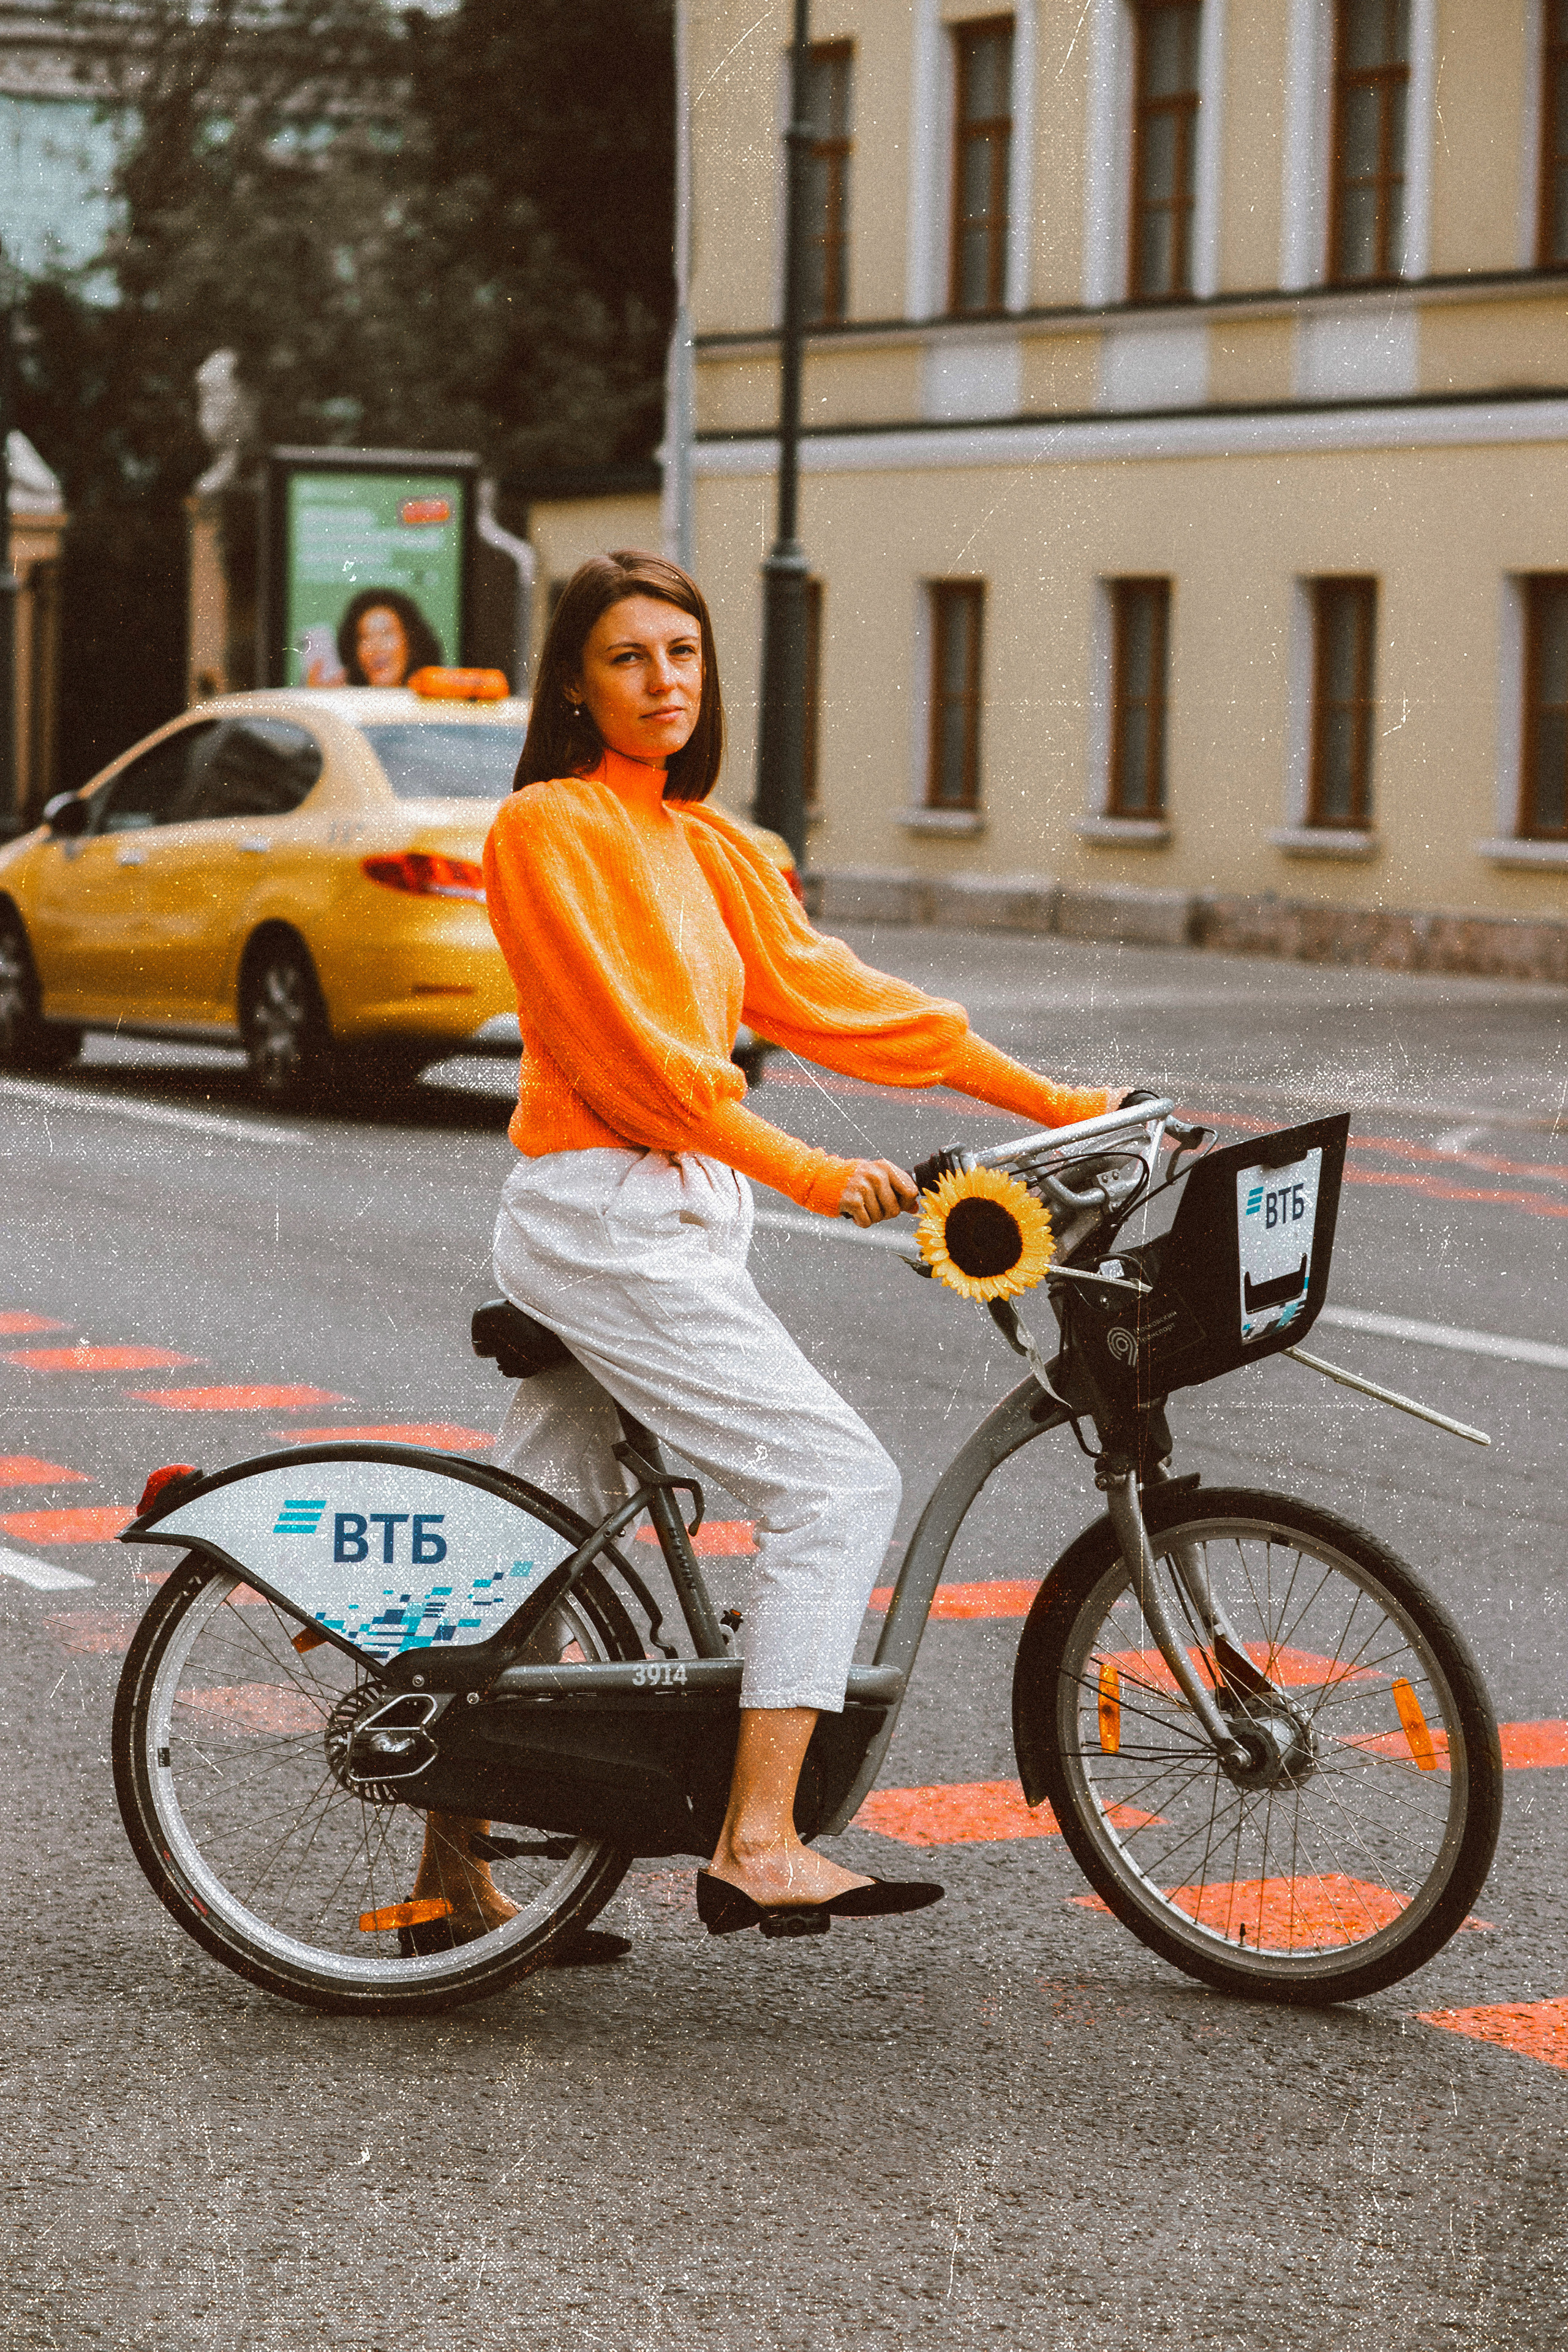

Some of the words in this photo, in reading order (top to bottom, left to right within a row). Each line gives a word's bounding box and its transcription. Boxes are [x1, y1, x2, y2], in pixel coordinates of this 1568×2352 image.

[1265, 1183, 1305, 1229] ВТБ
[333, 1512, 448, 1564] ВТБ
[632, 1662, 688, 1686] 3914
